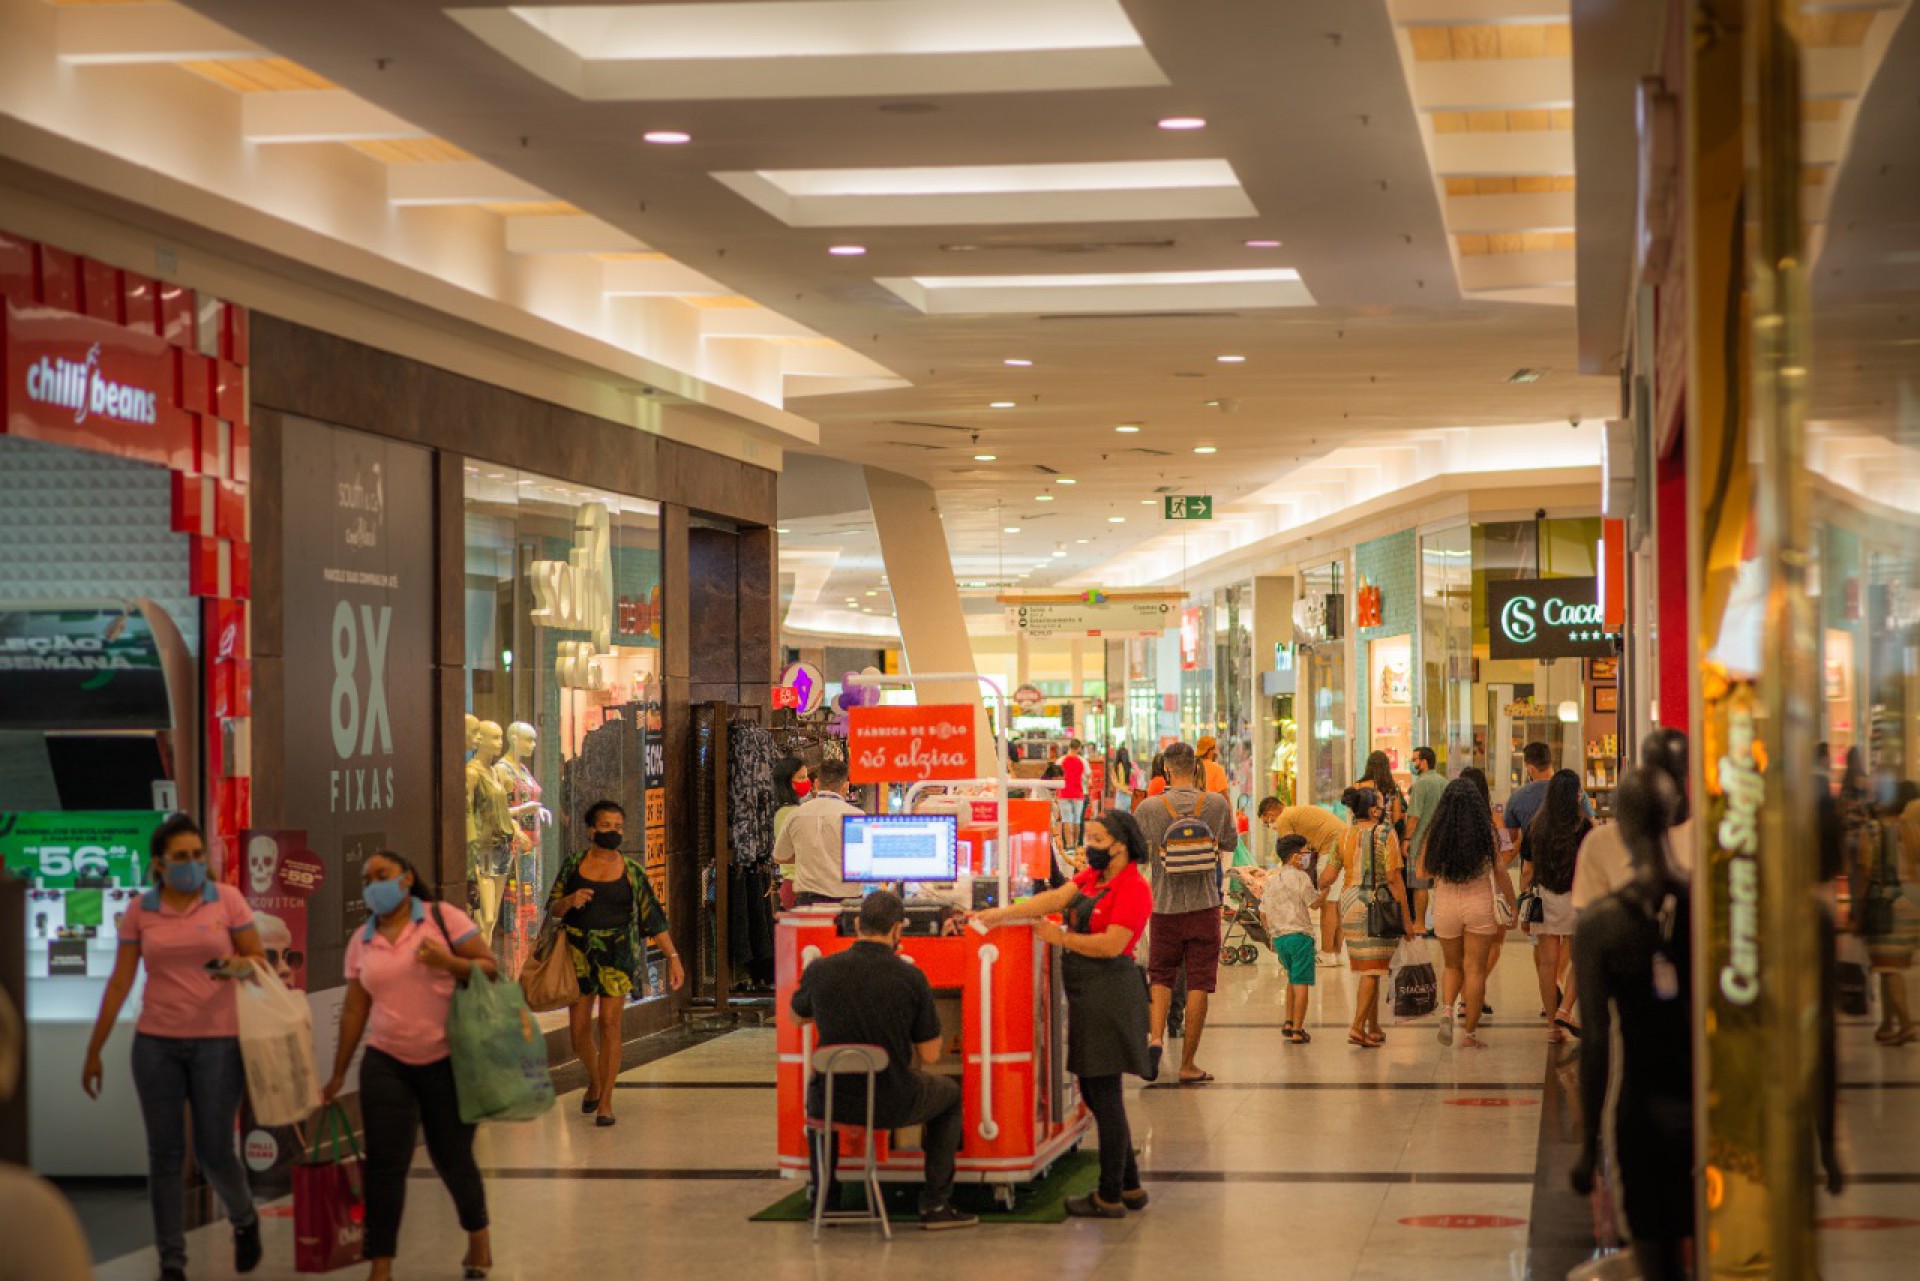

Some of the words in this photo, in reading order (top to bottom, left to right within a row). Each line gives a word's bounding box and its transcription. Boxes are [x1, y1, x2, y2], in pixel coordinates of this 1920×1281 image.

[90, 368, 157, 425] beans
[0, 634, 102, 655] EÇÃO
[331, 600, 394, 759] 8X
[910, 726, 925, 737] DE
[894, 738, 967, 779] alzira
[331, 767, 394, 813] FIXAS
